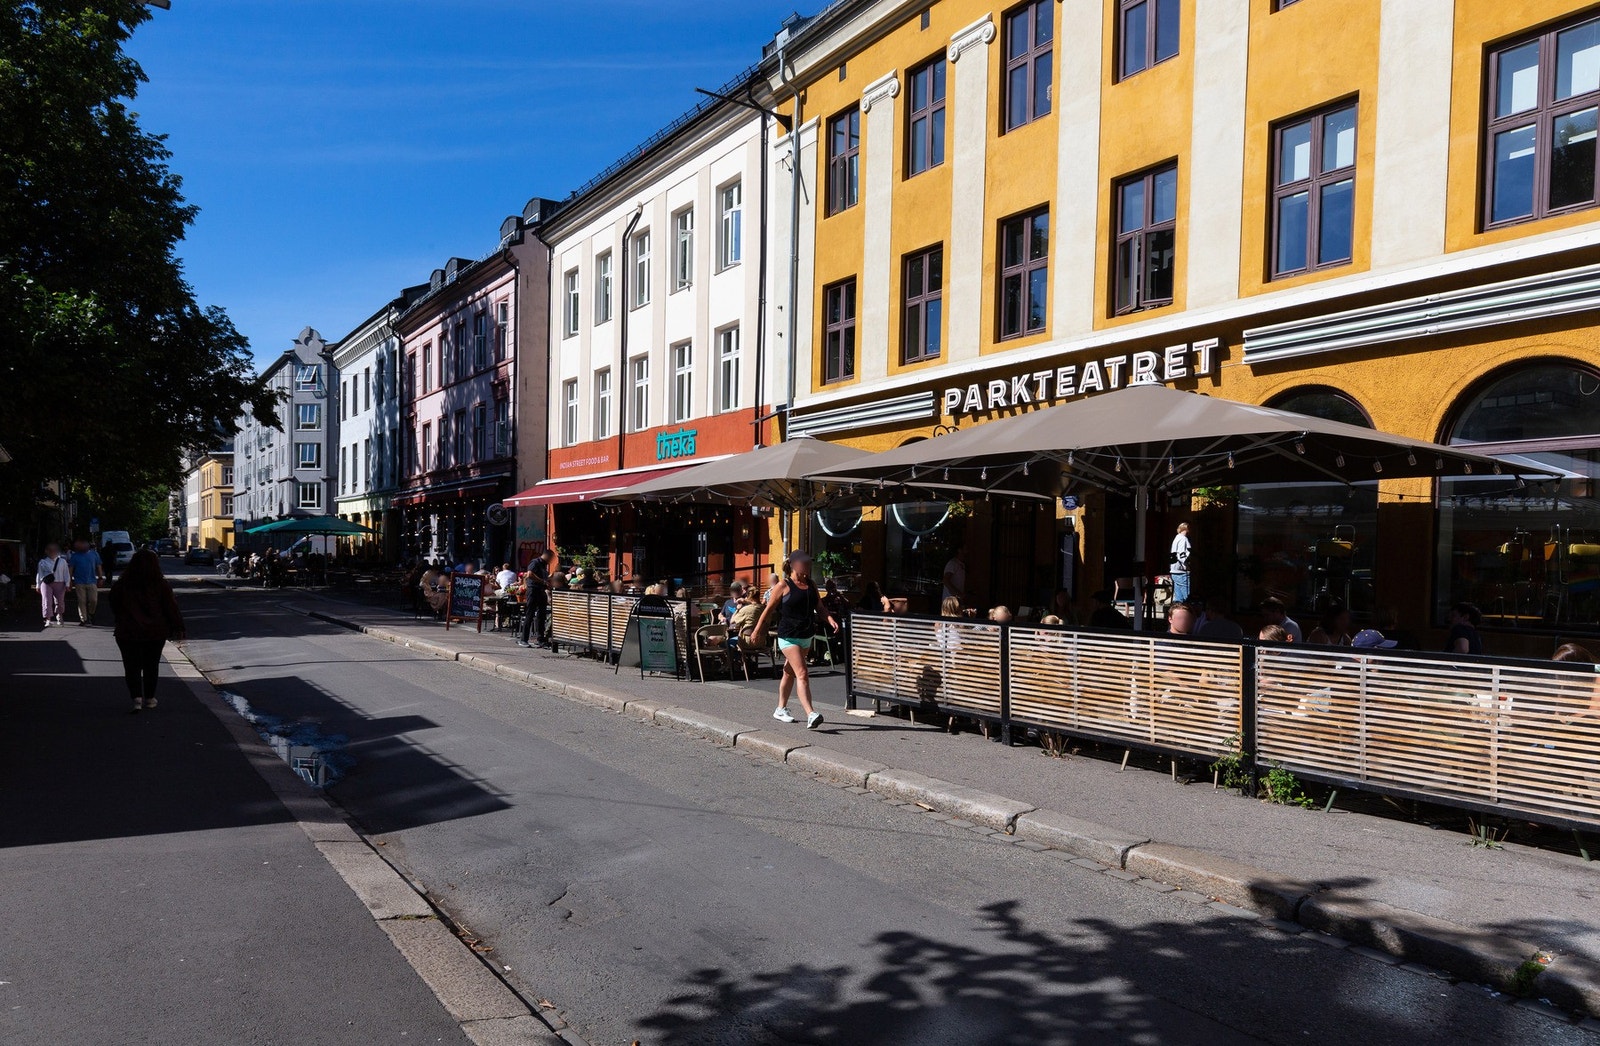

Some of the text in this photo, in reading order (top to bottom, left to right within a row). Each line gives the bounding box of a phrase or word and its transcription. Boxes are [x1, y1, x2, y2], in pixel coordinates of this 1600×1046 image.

[944, 337, 1219, 415] PARKTEATRET
[657, 428, 697, 459] theka
[559, 462, 572, 470] INDIAN
[572, 459, 586, 468] STREET
[586, 457, 597, 466] FOOD
[601, 455, 610, 463] BAR
[454, 576, 481, 587] DAGENS
